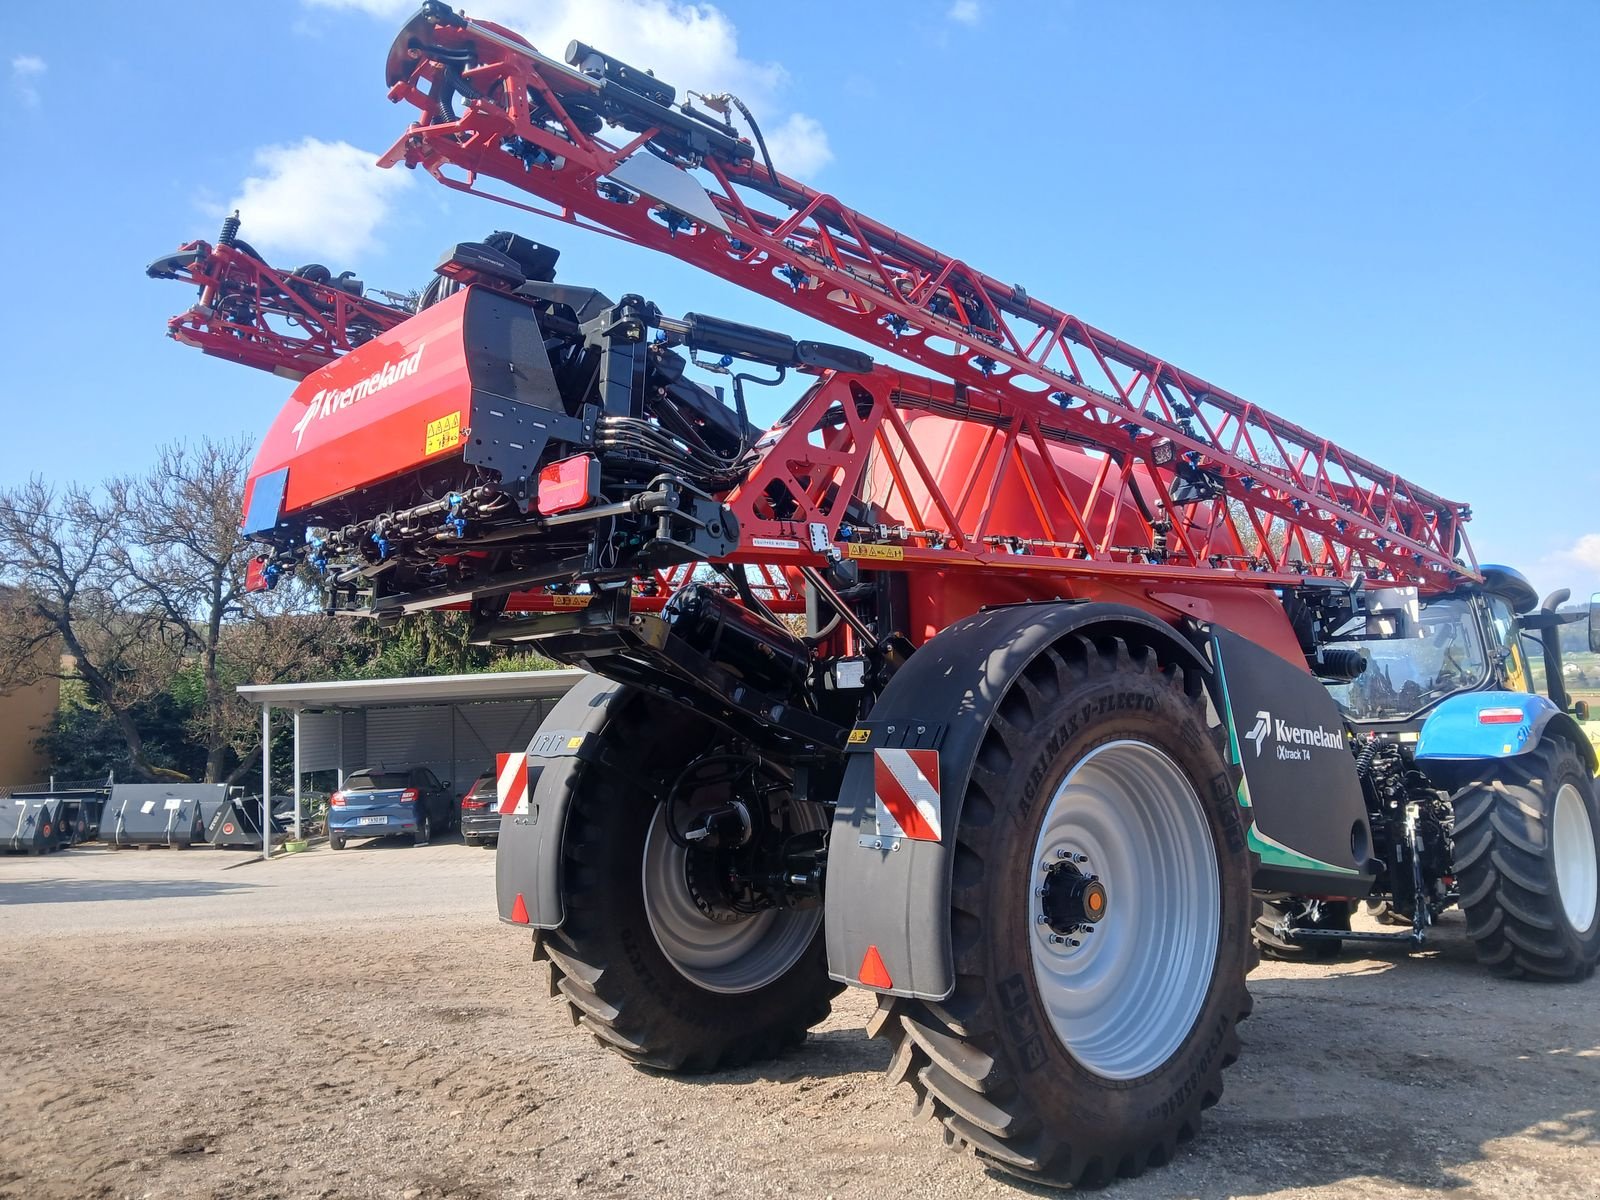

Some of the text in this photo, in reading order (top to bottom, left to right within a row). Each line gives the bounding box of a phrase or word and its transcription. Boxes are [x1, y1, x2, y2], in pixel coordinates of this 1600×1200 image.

[319, 342, 426, 419] Kverneland
[1018, 692, 1154, 819] AGRIMAX V-FLECTO
[1275, 719, 1344, 750] Kverneland
[1276, 745, 1311, 760] iXtrack T4
